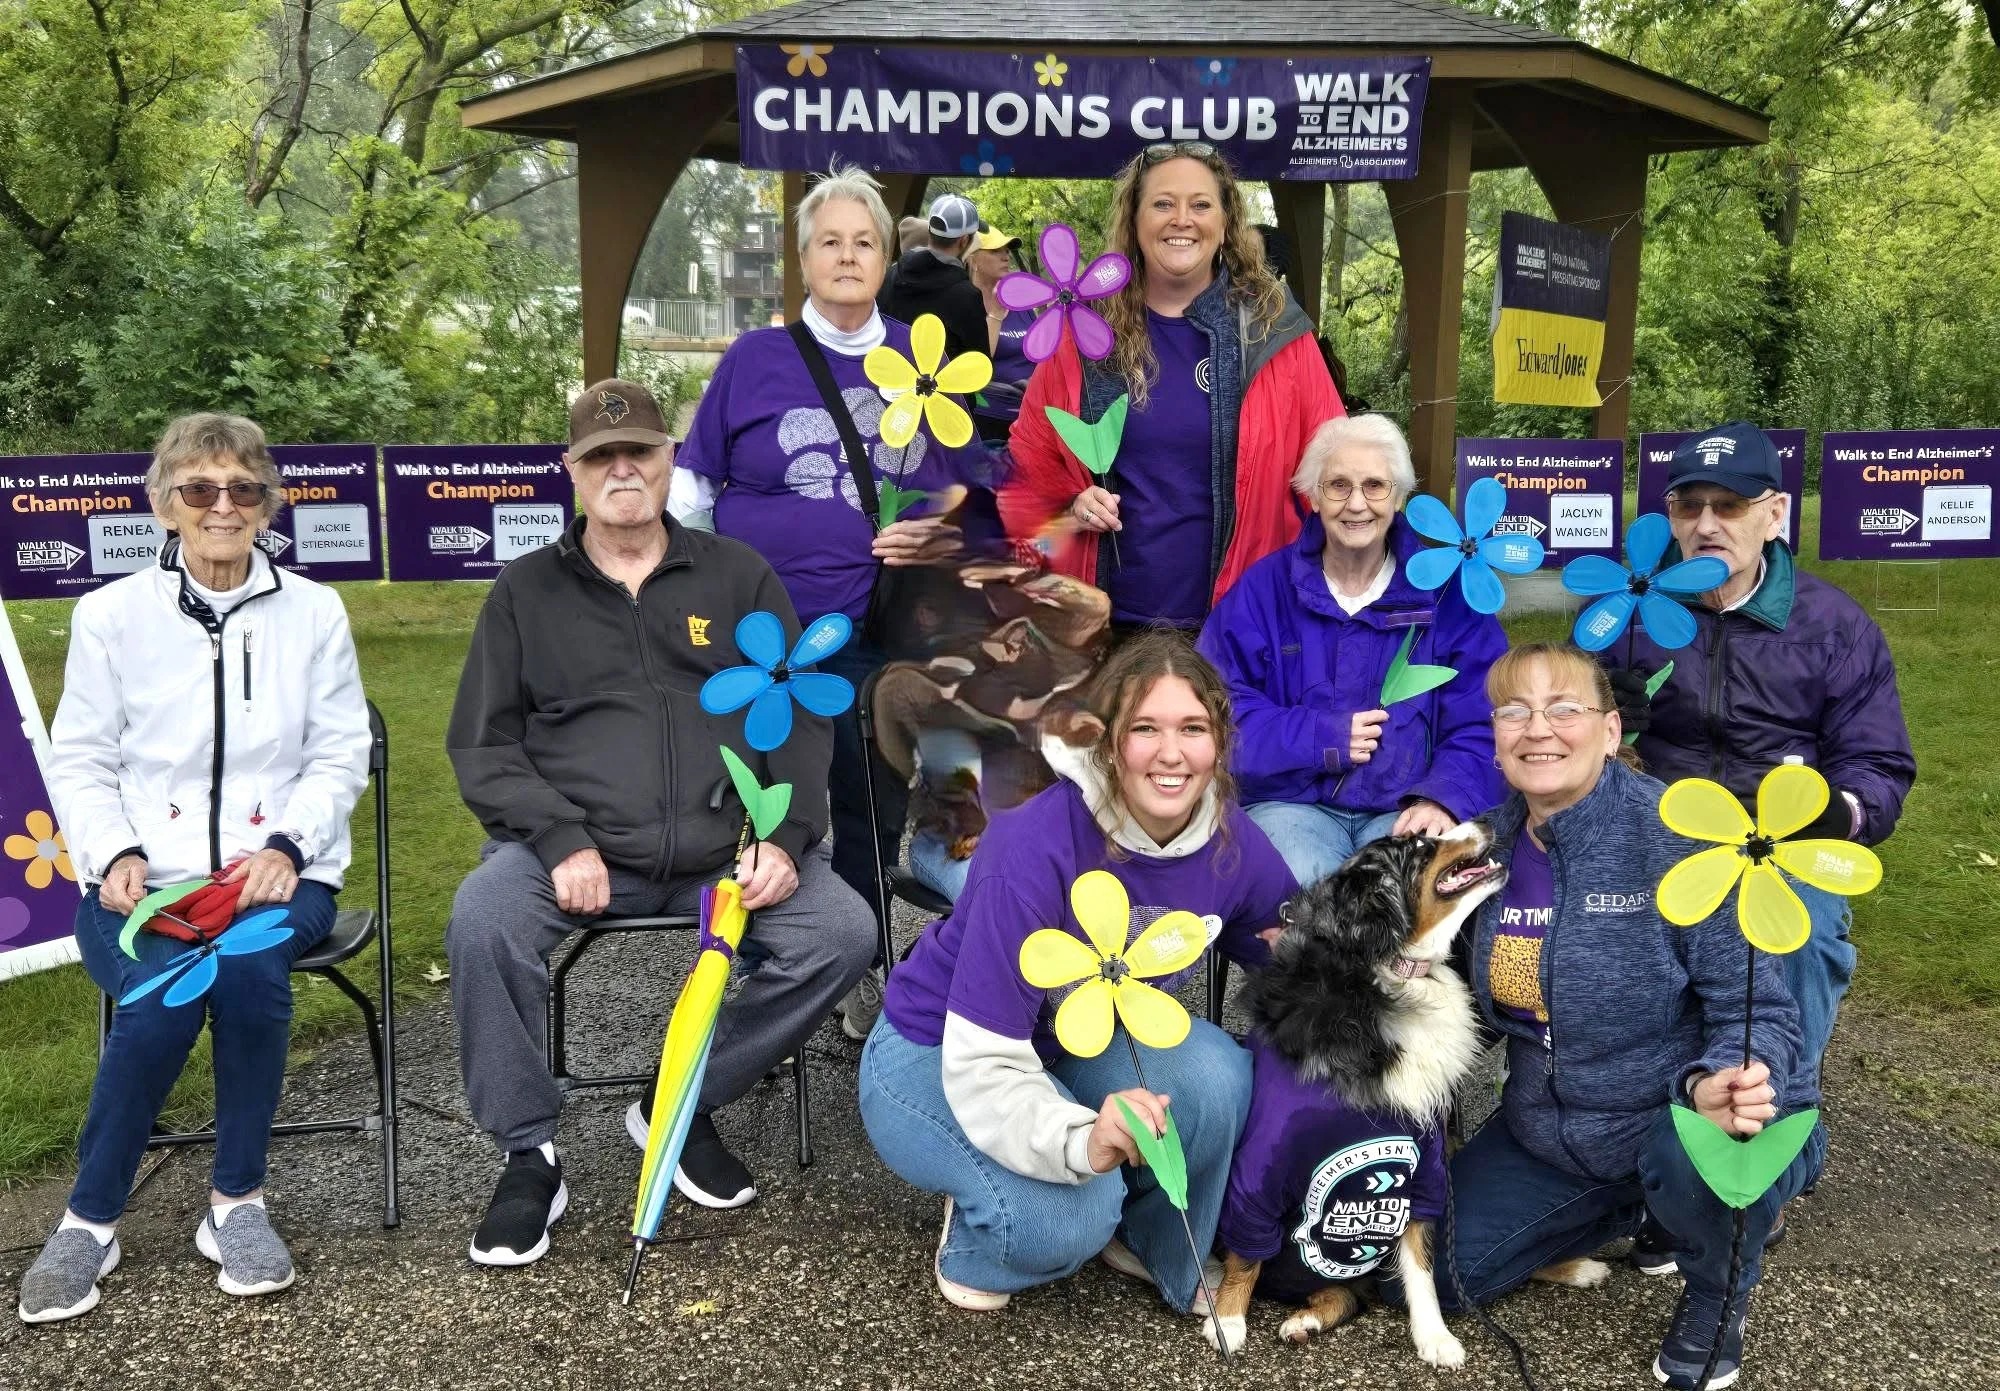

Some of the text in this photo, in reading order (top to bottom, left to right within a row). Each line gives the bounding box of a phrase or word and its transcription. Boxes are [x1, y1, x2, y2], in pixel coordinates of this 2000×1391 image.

[1294, 73, 1412, 103] WALK
[753, 86, 1278, 141] CHAMPIONS CLUB
[1300, 105, 1410, 135] TO END
[1291, 135, 1408, 151] ALZHEIMER'S
[1289, 157, 1407, 167] ALZHEIMER'S ASSOCIATION
[1517, 338, 1561, 376] Edward
[1650, 450, 1676, 463] Wal
[1835, 446, 1992, 461] Walk to End Alzheimer's
[1466, 455, 1612, 468] Walk to End Alzheimer's
[282, 463, 365, 477] Alzheimer's
[395, 462, 562, 476] Walk to End Alzheimer's
[1862, 463, 1965, 486] Champion
[0, 473, 147, 489] lk to End Alzheimer
[1494, 472, 1588, 495] Champion
[280, 481, 337, 506] pion
[427, 479, 535, 503] Champion
[12, 491, 132, 517] Champion
[1940, 500, 1974, 510] KELLIE
[1560, 508, 1603, 519] JACLYN
[1862, 508, 1900, 516] WALK TO
[499, 514, 560, 526] RHONDA
[1518, 515, 1529, 523] TO
[1862, 516, 1899, 525] END
[1927, 515, 1986, 525] ANDERSON
[103, 525, 155, 537] RENEA
[313, 523, 351, 533] JACKIE
[431, 526, 471, 534] WALK TO
[1494, 523, 1529, 532] END
[1555, 527, 1608, 537] WANGEN
[17, 540, 61, 550] WALK TO
[302, 539, 365, 549] STIERNAGLE
[432, 535, 471, 544] END
[508, 535, 551, 547] TUFTE
[18, 550, 62, 561] END
[103, 546, 157, 559] HAGEN
[1524, 908, 1553, 926] TIM
[1309, 1150, 1370, 1213] ALZHEIMER'S
[1333, 1198, 1400, 1215] WALK TO
[1327, 1211, 1397, 1228] END
